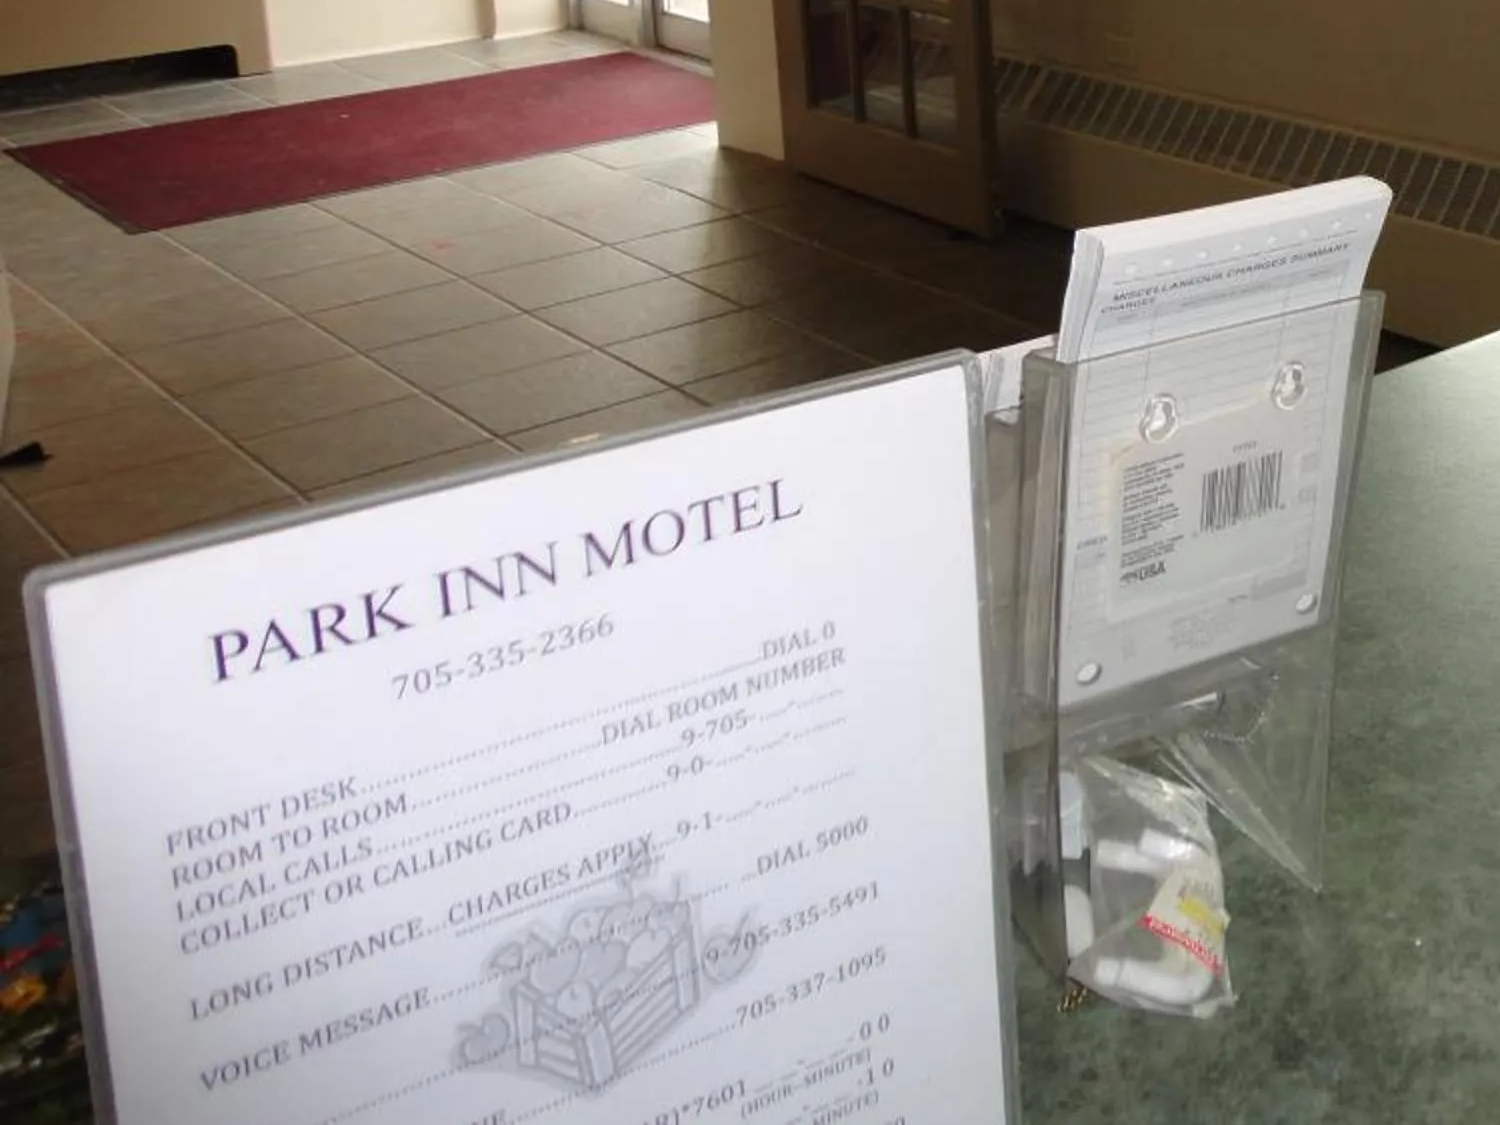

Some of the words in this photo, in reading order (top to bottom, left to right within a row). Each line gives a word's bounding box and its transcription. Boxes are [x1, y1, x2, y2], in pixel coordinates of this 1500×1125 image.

[1226, 257, 1287, 278] CHARGES
[1290, 243, 1349, 264] SUMMARY
[207, 582, 415, 683] PARK
[432, 542, 560, 619] INN
[582, 477, 804, 578] MOTEL
[390, 612, 616, 701] 705-335-2366
[166, 801, 271, 857] FRONT
[280, 775, 359, 821] DESK
[761, 629, 817, 661] DIAL
[170, 841, 264, 890] ROOM
[271, 825, 312, 855] TO
[321, 792, 408, 840] ROOM
[601, 711, 660, 746] DIAL
[667, 682, 738, 723] ROOM
[746, 647, 847, 697] NUMBER
[176, 873, 276, 922] LOCAL
[283, 836, 374, 885] CALLS
[179, 888, 315, 956] COLLECT
[324, 874, 364, 906] OR
[373, 828, 493, 887] CALLING
[500, 801, 573, 843] CARD
[189, 972, 273, 1021] LONG
[282, 916, 425, 988] DISTANCE
[448, 862, 571, 926] CHARGES
[577, 832, 654, 879] APPLY
[199, 1040, 291, 1092] VOICE
[298, 986, 430, 1057] MESSAGE
[756, 841, 810, 876] DIAL
[816, 814, 869, 850] 5000
